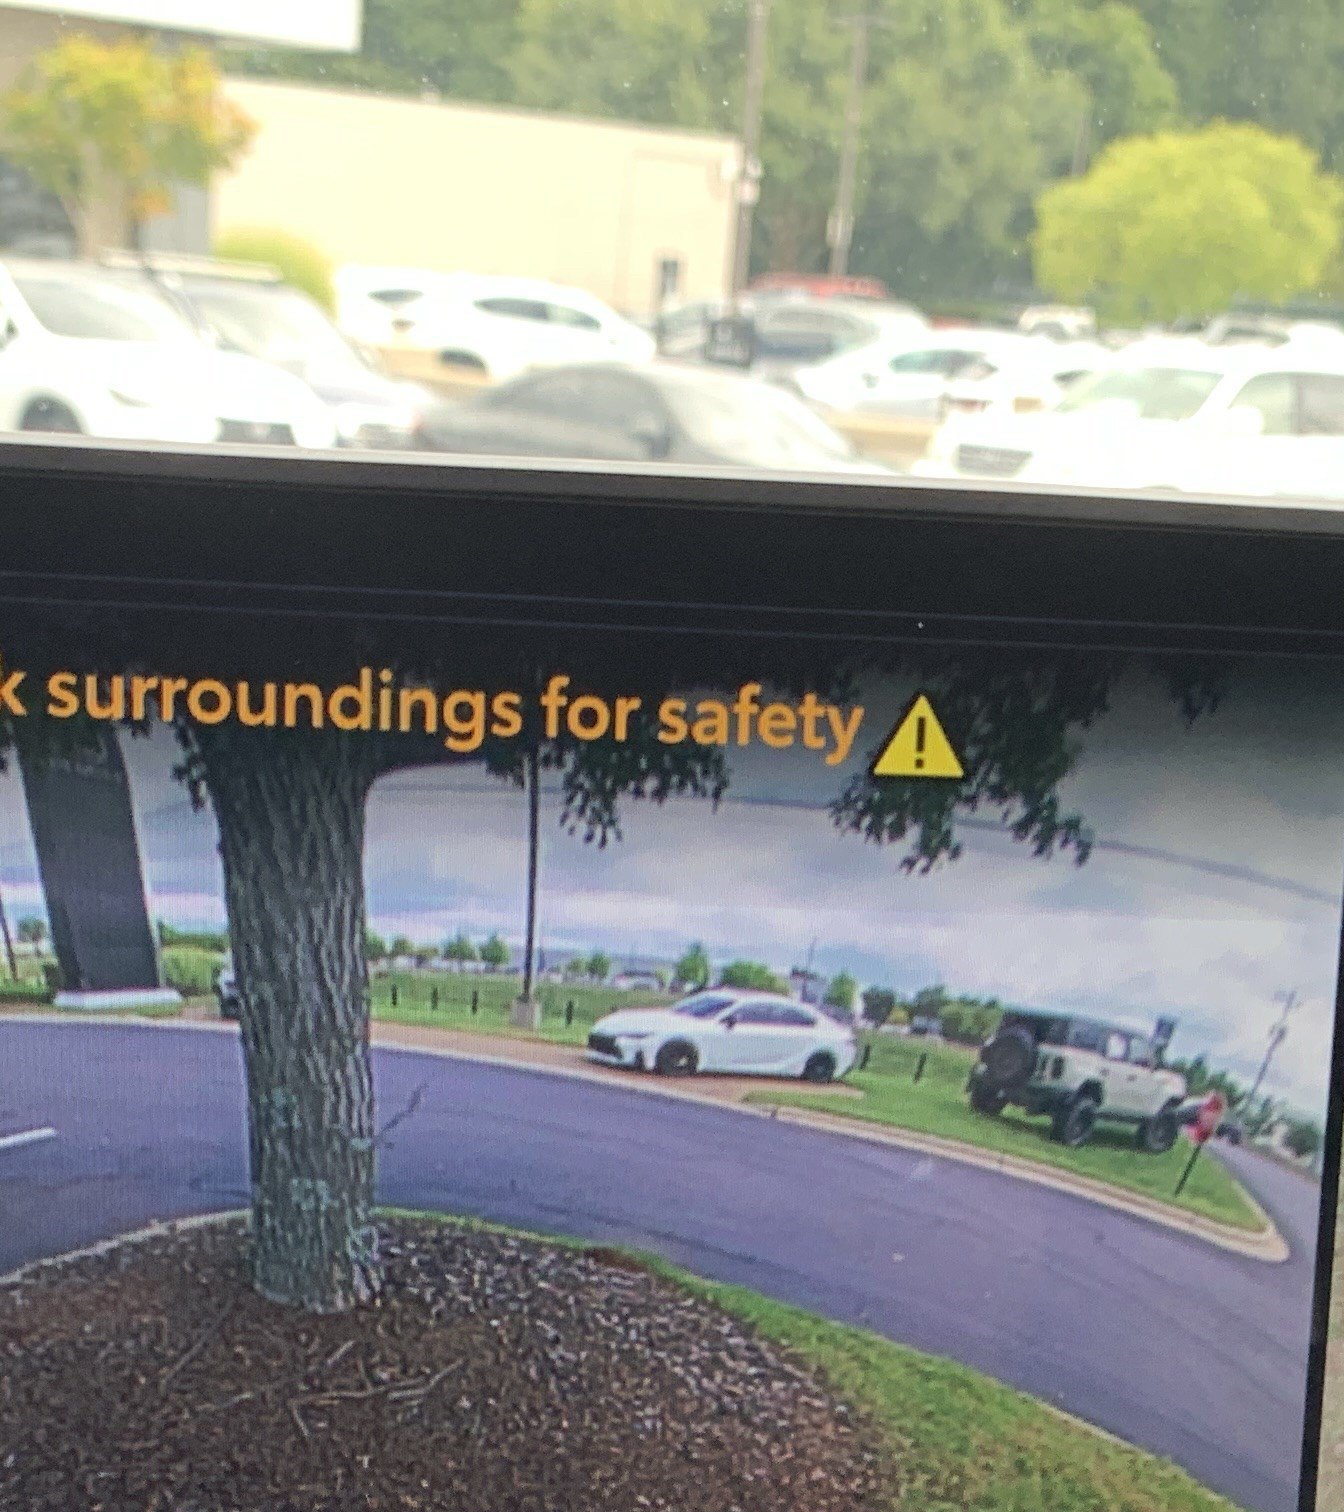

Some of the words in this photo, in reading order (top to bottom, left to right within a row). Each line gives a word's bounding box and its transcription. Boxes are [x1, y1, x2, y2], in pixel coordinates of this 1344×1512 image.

[47, 668, 523, 753] surroundings
[539, 677, 641, 741] for
[657, 684, 864, 766] safety
